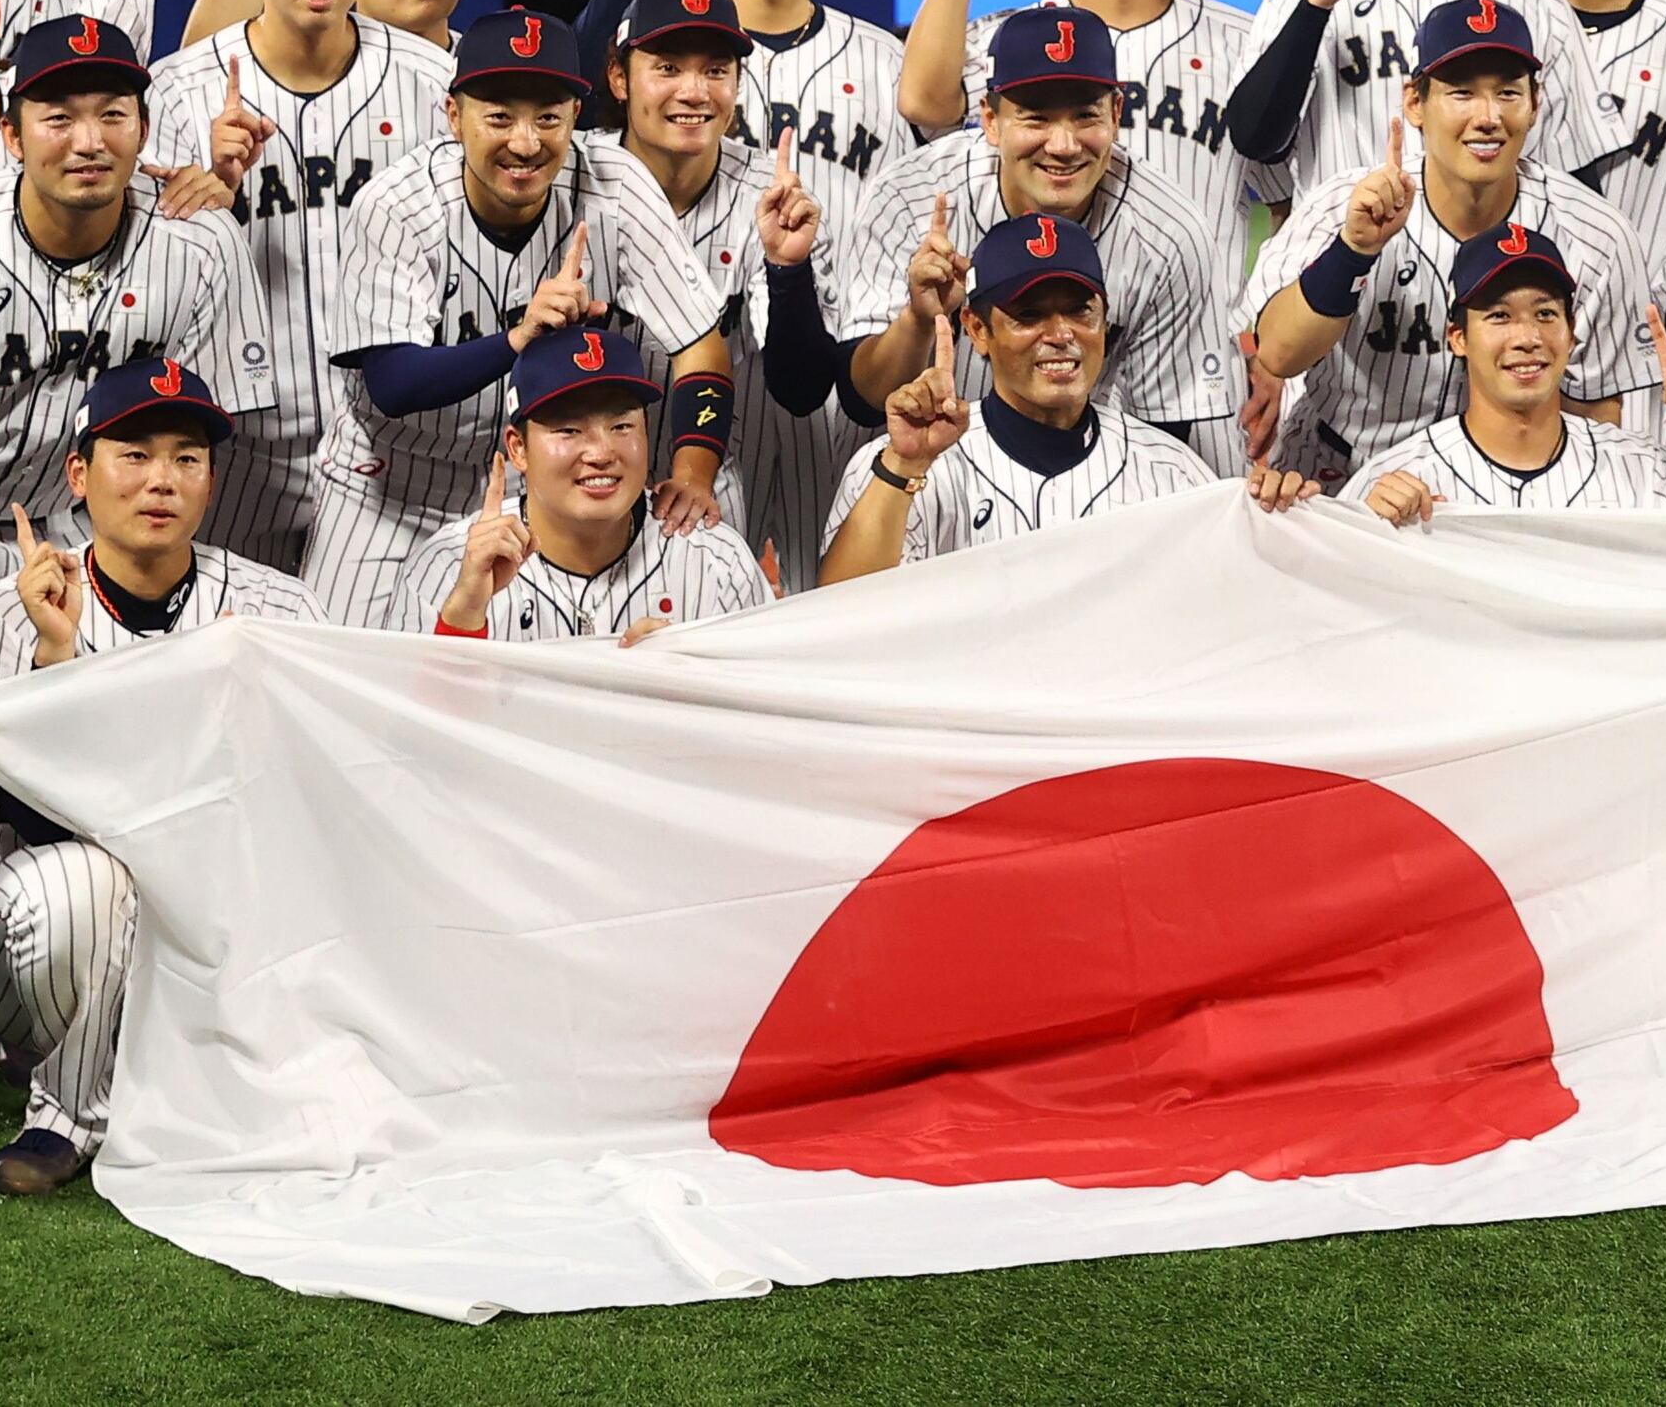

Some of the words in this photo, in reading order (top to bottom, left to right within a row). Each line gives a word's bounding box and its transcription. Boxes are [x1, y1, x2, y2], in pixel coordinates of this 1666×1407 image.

[68, 16, 100, 55] J
[510, 17, 542, 58] J
[1044, 20, 1075, 63] J
[1119, 81, 1229, 155] PAN
[734, 101, 882, 180] APAN
[233, 156, 373, 225] APA
[1026, 217, 1058, 258] J
[1497, 222, 1528, 256] J
[573, 332, 605, 372] J
[150, 357, 182, 397] J
